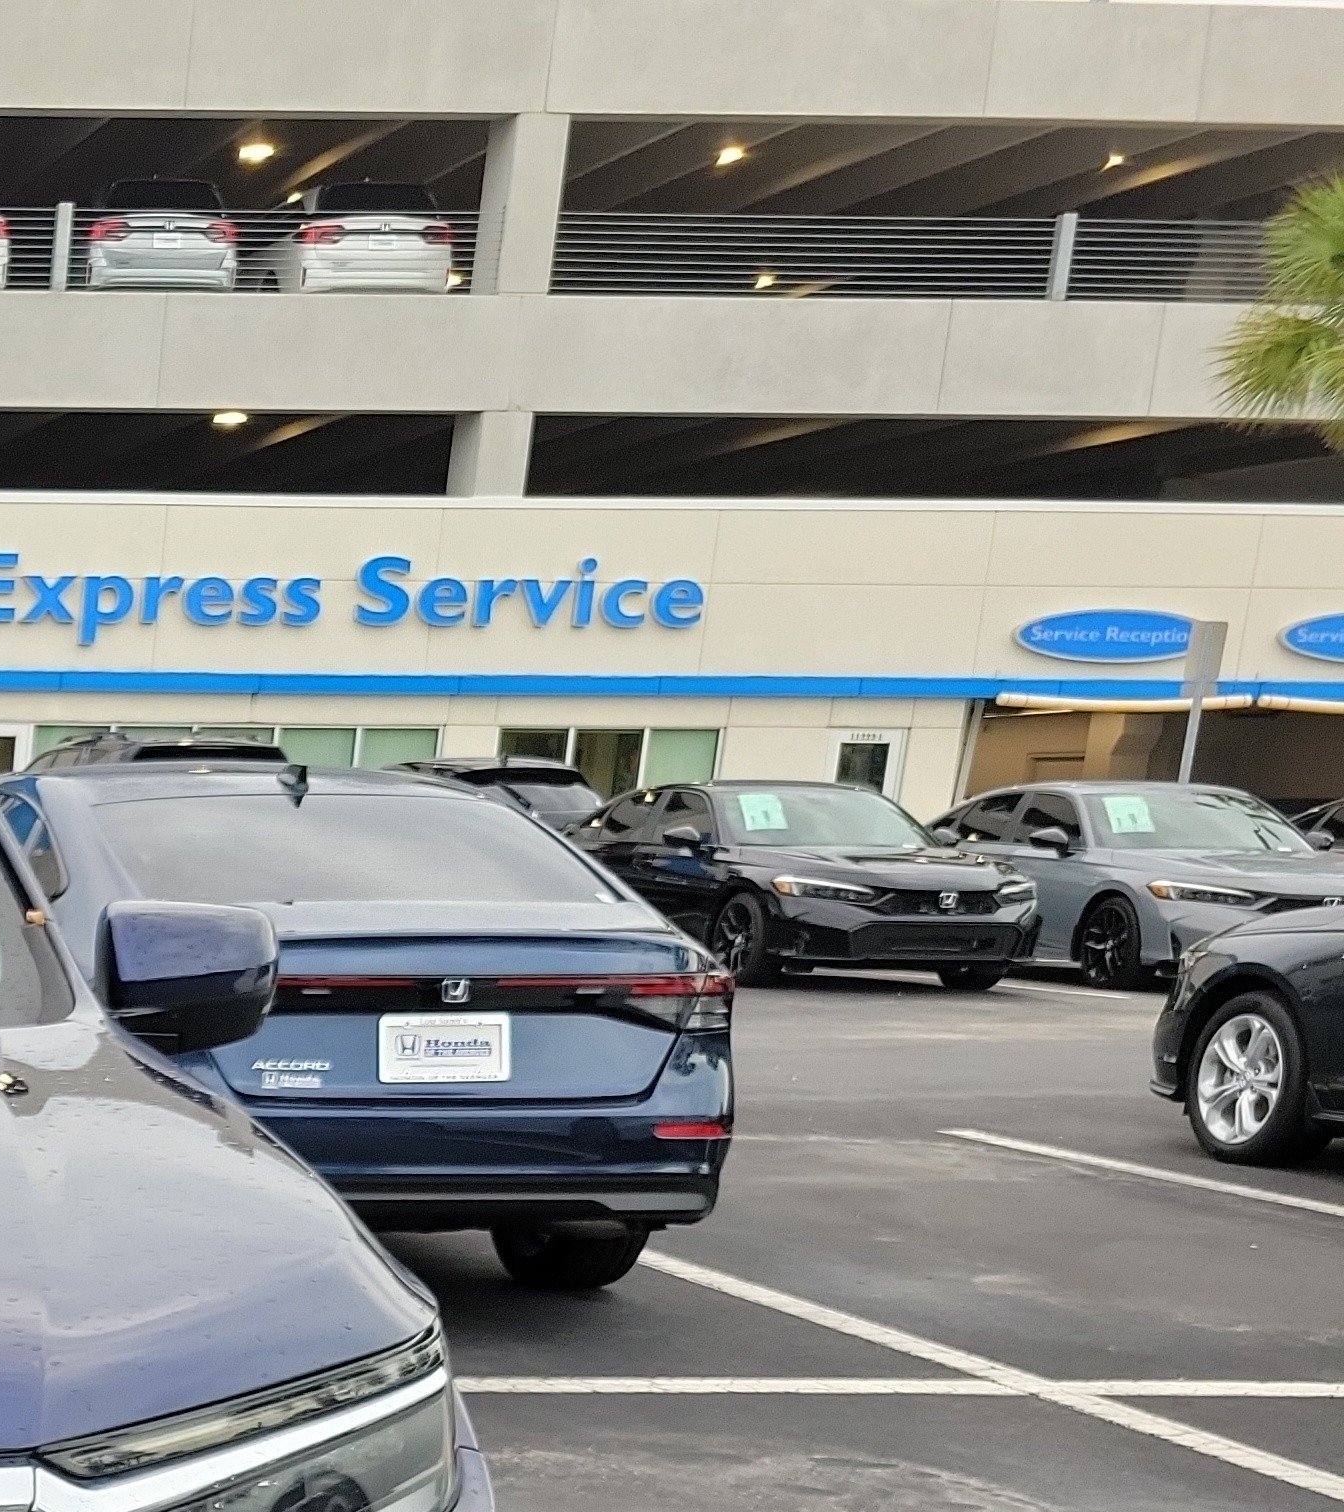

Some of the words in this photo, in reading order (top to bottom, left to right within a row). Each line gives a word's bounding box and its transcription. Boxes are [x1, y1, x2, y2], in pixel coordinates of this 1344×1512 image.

[354, 555, 705, 629] Service
[1030, 624, 1100, 642] Service
[1106, 626, 1187, 646] Receptio
[424, 1038, 492, 1048] Honda
[251, 1060, 330, 1071] ACCORD
